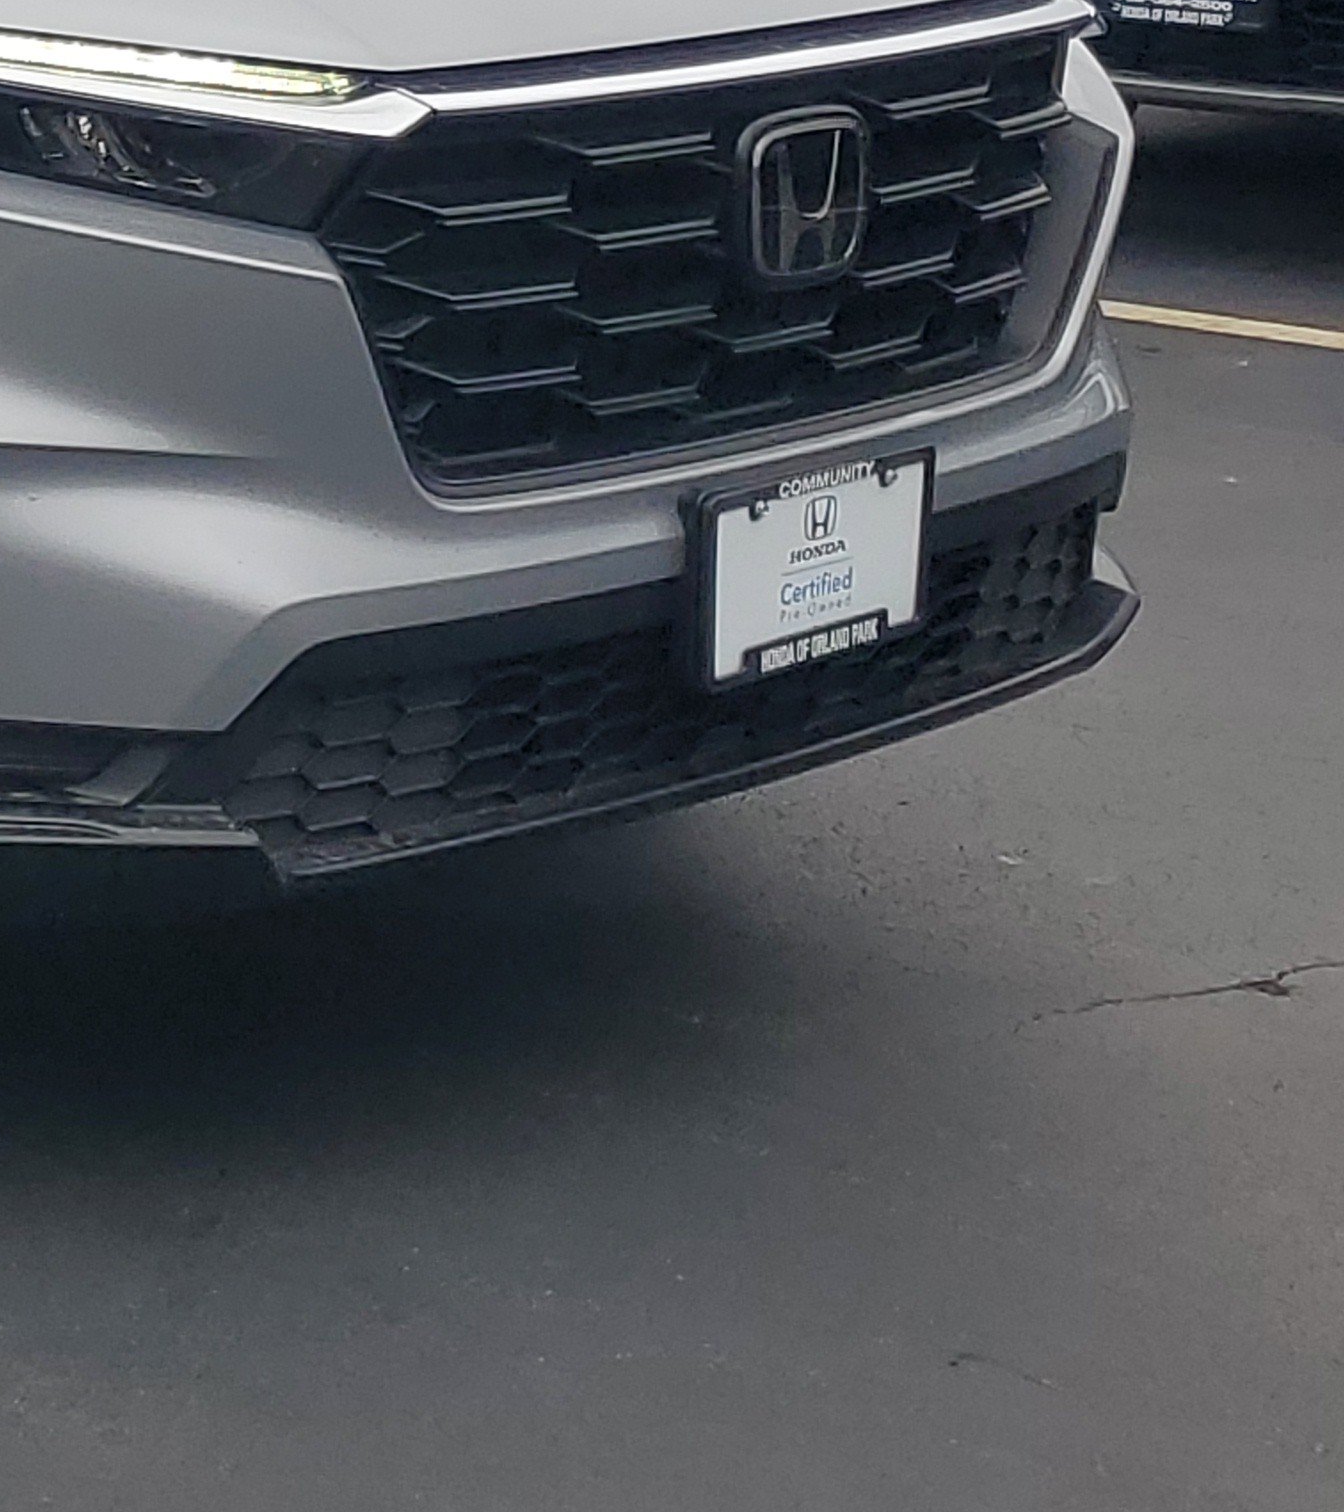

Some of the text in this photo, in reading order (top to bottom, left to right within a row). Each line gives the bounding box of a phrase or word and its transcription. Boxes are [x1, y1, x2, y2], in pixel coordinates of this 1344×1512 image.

[778, 461, 875, 498] COMMUNITY
[788, 540, 846, 564] HONDA
[780, 567, 852, 606] Certified
[761, 642, 795, 673] HONDA
[797, 638, 811, 662] OF
[852, 618, 879, 646] PARK
